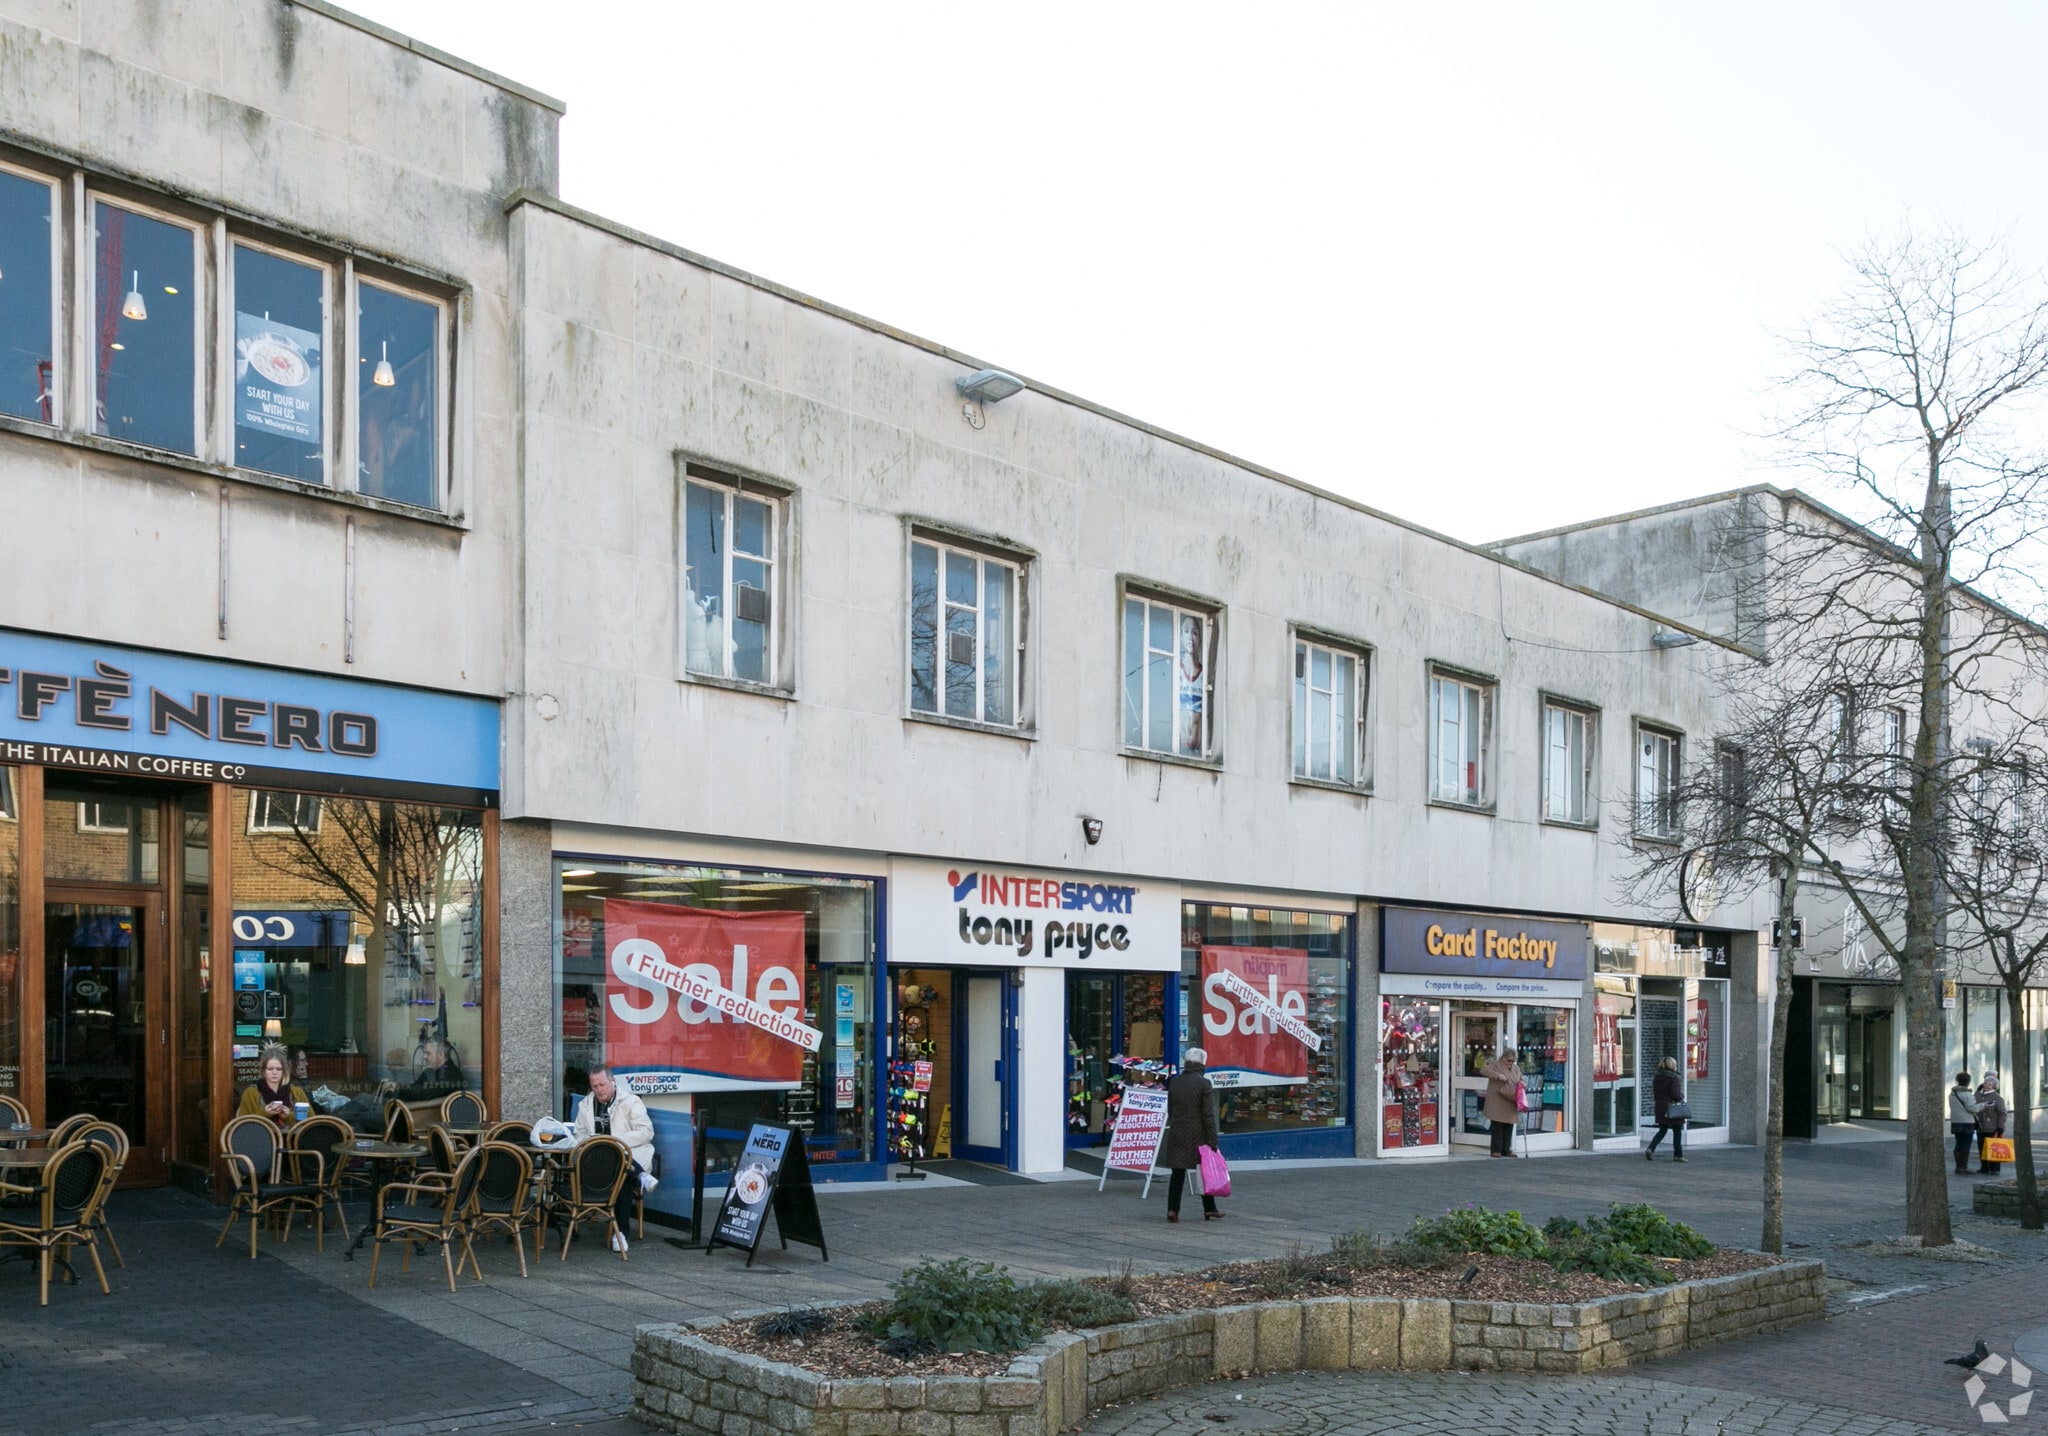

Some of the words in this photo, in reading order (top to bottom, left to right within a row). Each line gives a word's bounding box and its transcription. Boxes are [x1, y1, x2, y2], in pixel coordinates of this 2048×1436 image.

[246, 386, 271, 401] START
[273, 393, 294, 407] YOUR
[295, 399, 310, 411] DAY
[262, 402, 282, 416] WITH
[283, 408, 295, 420] US
[150, 685, 378, 757] NERO
[43, 746, 129, 769] ITALIAN
[137, 756, 214, 778] COFFEE
[981, 873, 1136, 914] INTERSPORT
[959, 907, 1033, 957] tony
[1044, 920, 1131, 960] pryce
[1426, 924, 1477, 957] Card
[1484, 929, 1557, 969] Factory
[608, 938, 800, 1025] Sale
[1496, 982, 1520, 992] Compare
[1521, 983, 1530, 991] the
[638, 954, 712, 1001] Further
[717, 991, 814, 1047] reductions
[1202, 972, 1306, 1036] Sale
[1225, 973, 1264, 1010] Further
[1265, 1003, 1317, 1048] reductions
[631, 1084, 651, 1093] tony
[653, 1084, 678, 1093] pryce
[635, 1075, 681, 1084] INTERSPORT
[1117, 1121, 1162, 1129] REDUCTIONS
[1119, 1113, 1164, 1123] FURTHER
[752, 1137, 781, 1151] NERO
[1112, 1139, 1157, 1147] REDUCTIONS
[1114, 1131, 1159, 1141] FURTHER
[1107, 1158, 1152, 1166] REDUCTIONS
[1109, 1150, 1154, 1160] FURTHER
